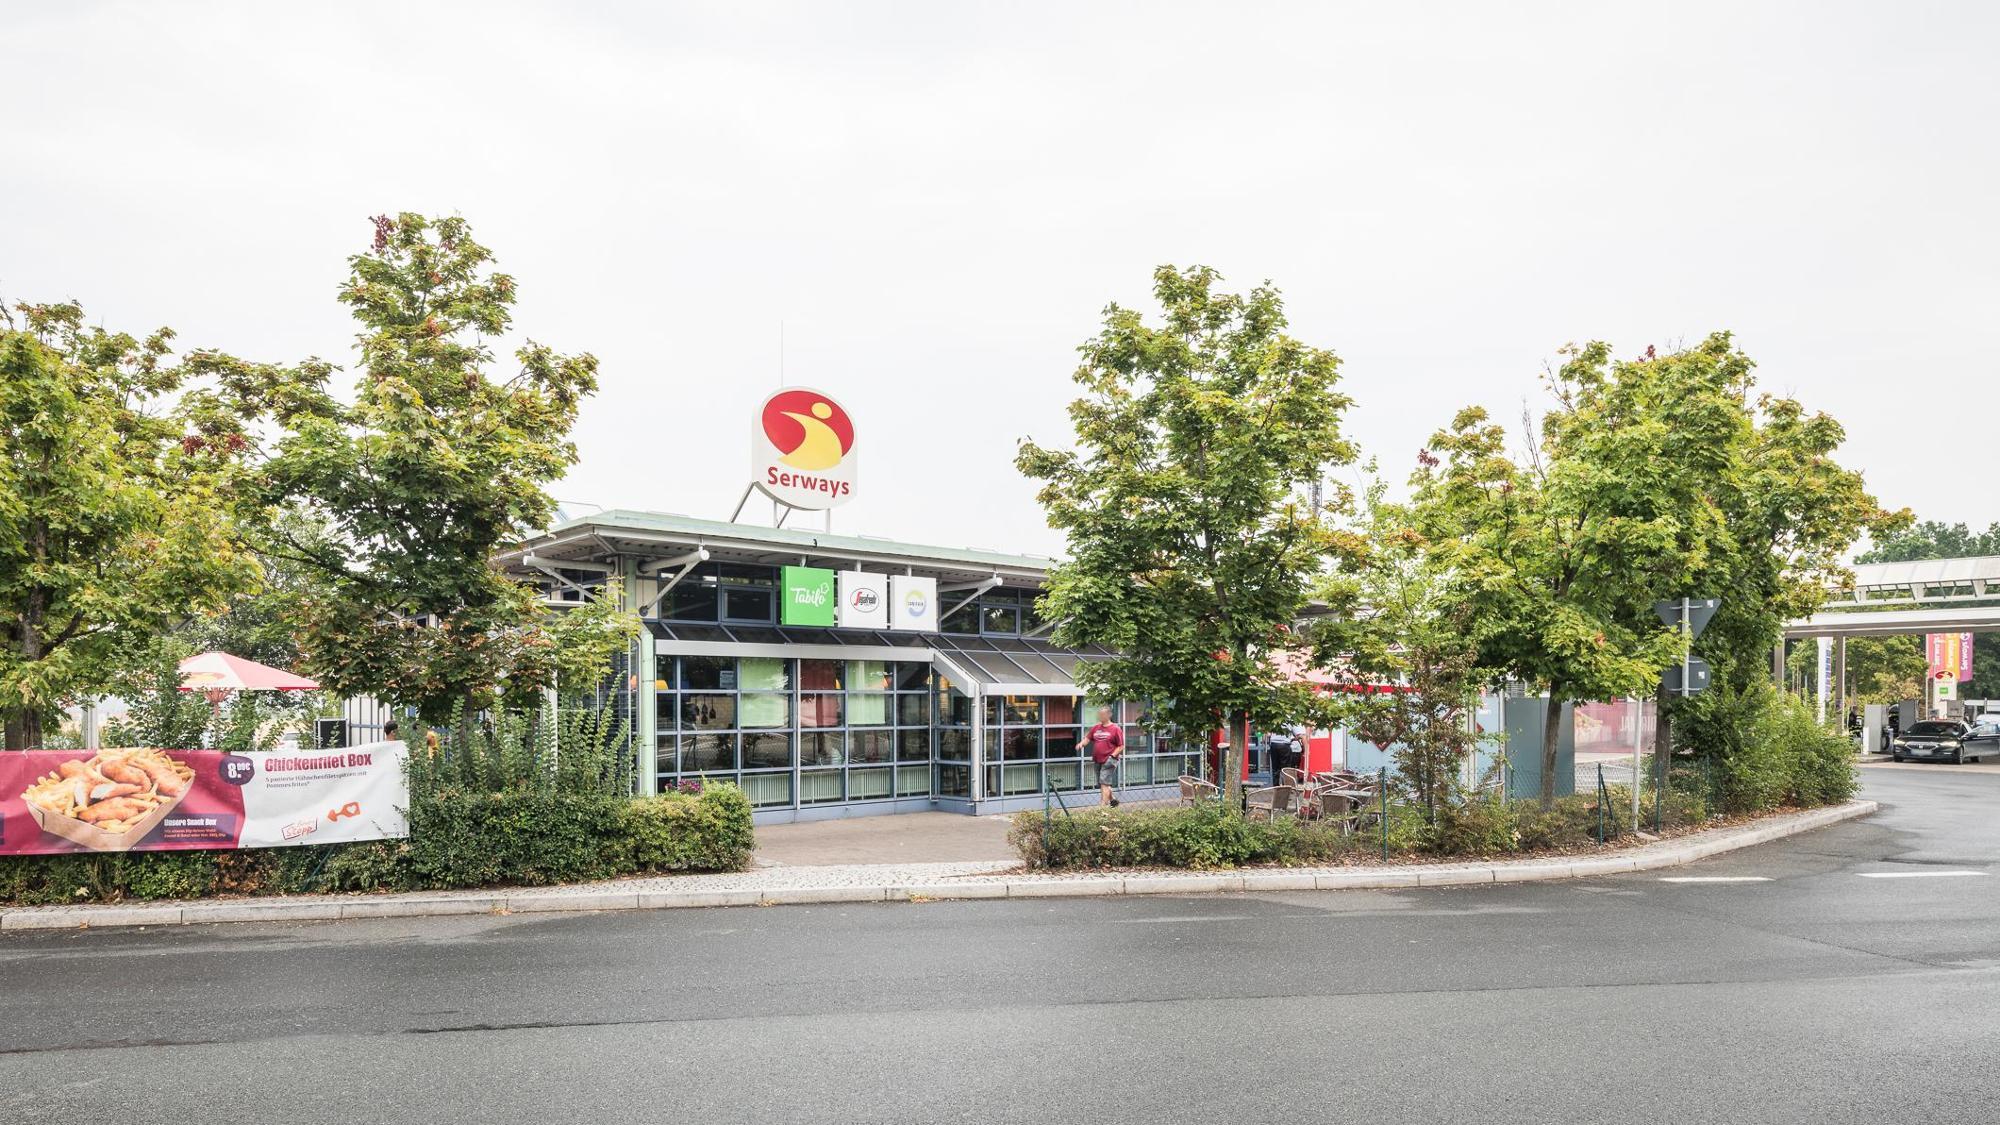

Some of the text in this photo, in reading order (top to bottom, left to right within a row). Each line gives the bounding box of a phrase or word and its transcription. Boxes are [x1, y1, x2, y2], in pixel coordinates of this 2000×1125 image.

[767, 466, 849, 498] Serways
[1960, 641, 1970, 671] Serways
[265, 753, 372, 772] Chickenfilet Box
